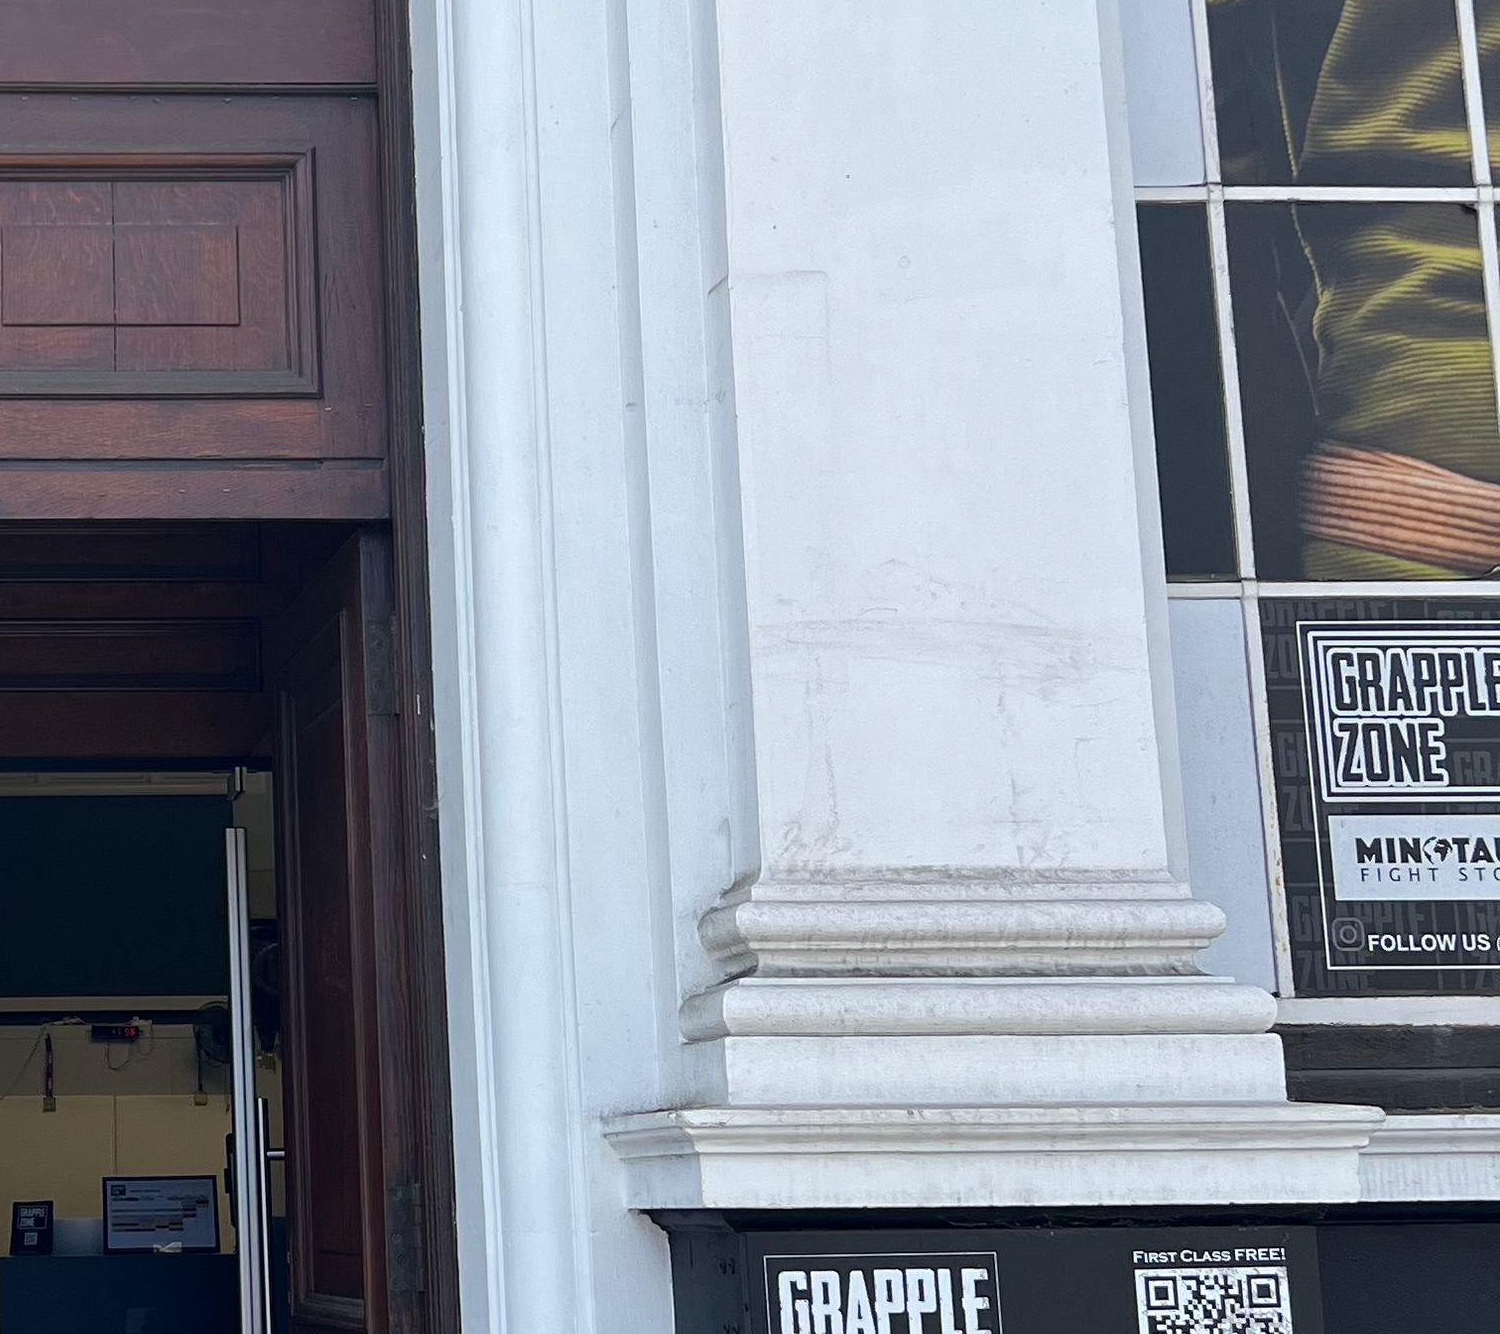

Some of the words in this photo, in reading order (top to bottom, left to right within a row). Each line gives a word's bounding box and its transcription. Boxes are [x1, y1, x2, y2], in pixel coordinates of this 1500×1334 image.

[1333, 720, 1446, 784] ZONE
[1360, 867, 1439, 883] FIGHT
[1367, 933, 1457, 952] FOLLOW
[1461, 933, 1492, 952] US
[1132, 1250, 1178, 1264] FIRST
[1180, 1249, 1232, 1263] CLASS
[1234, 1247, 1287, 1262] FREE!
